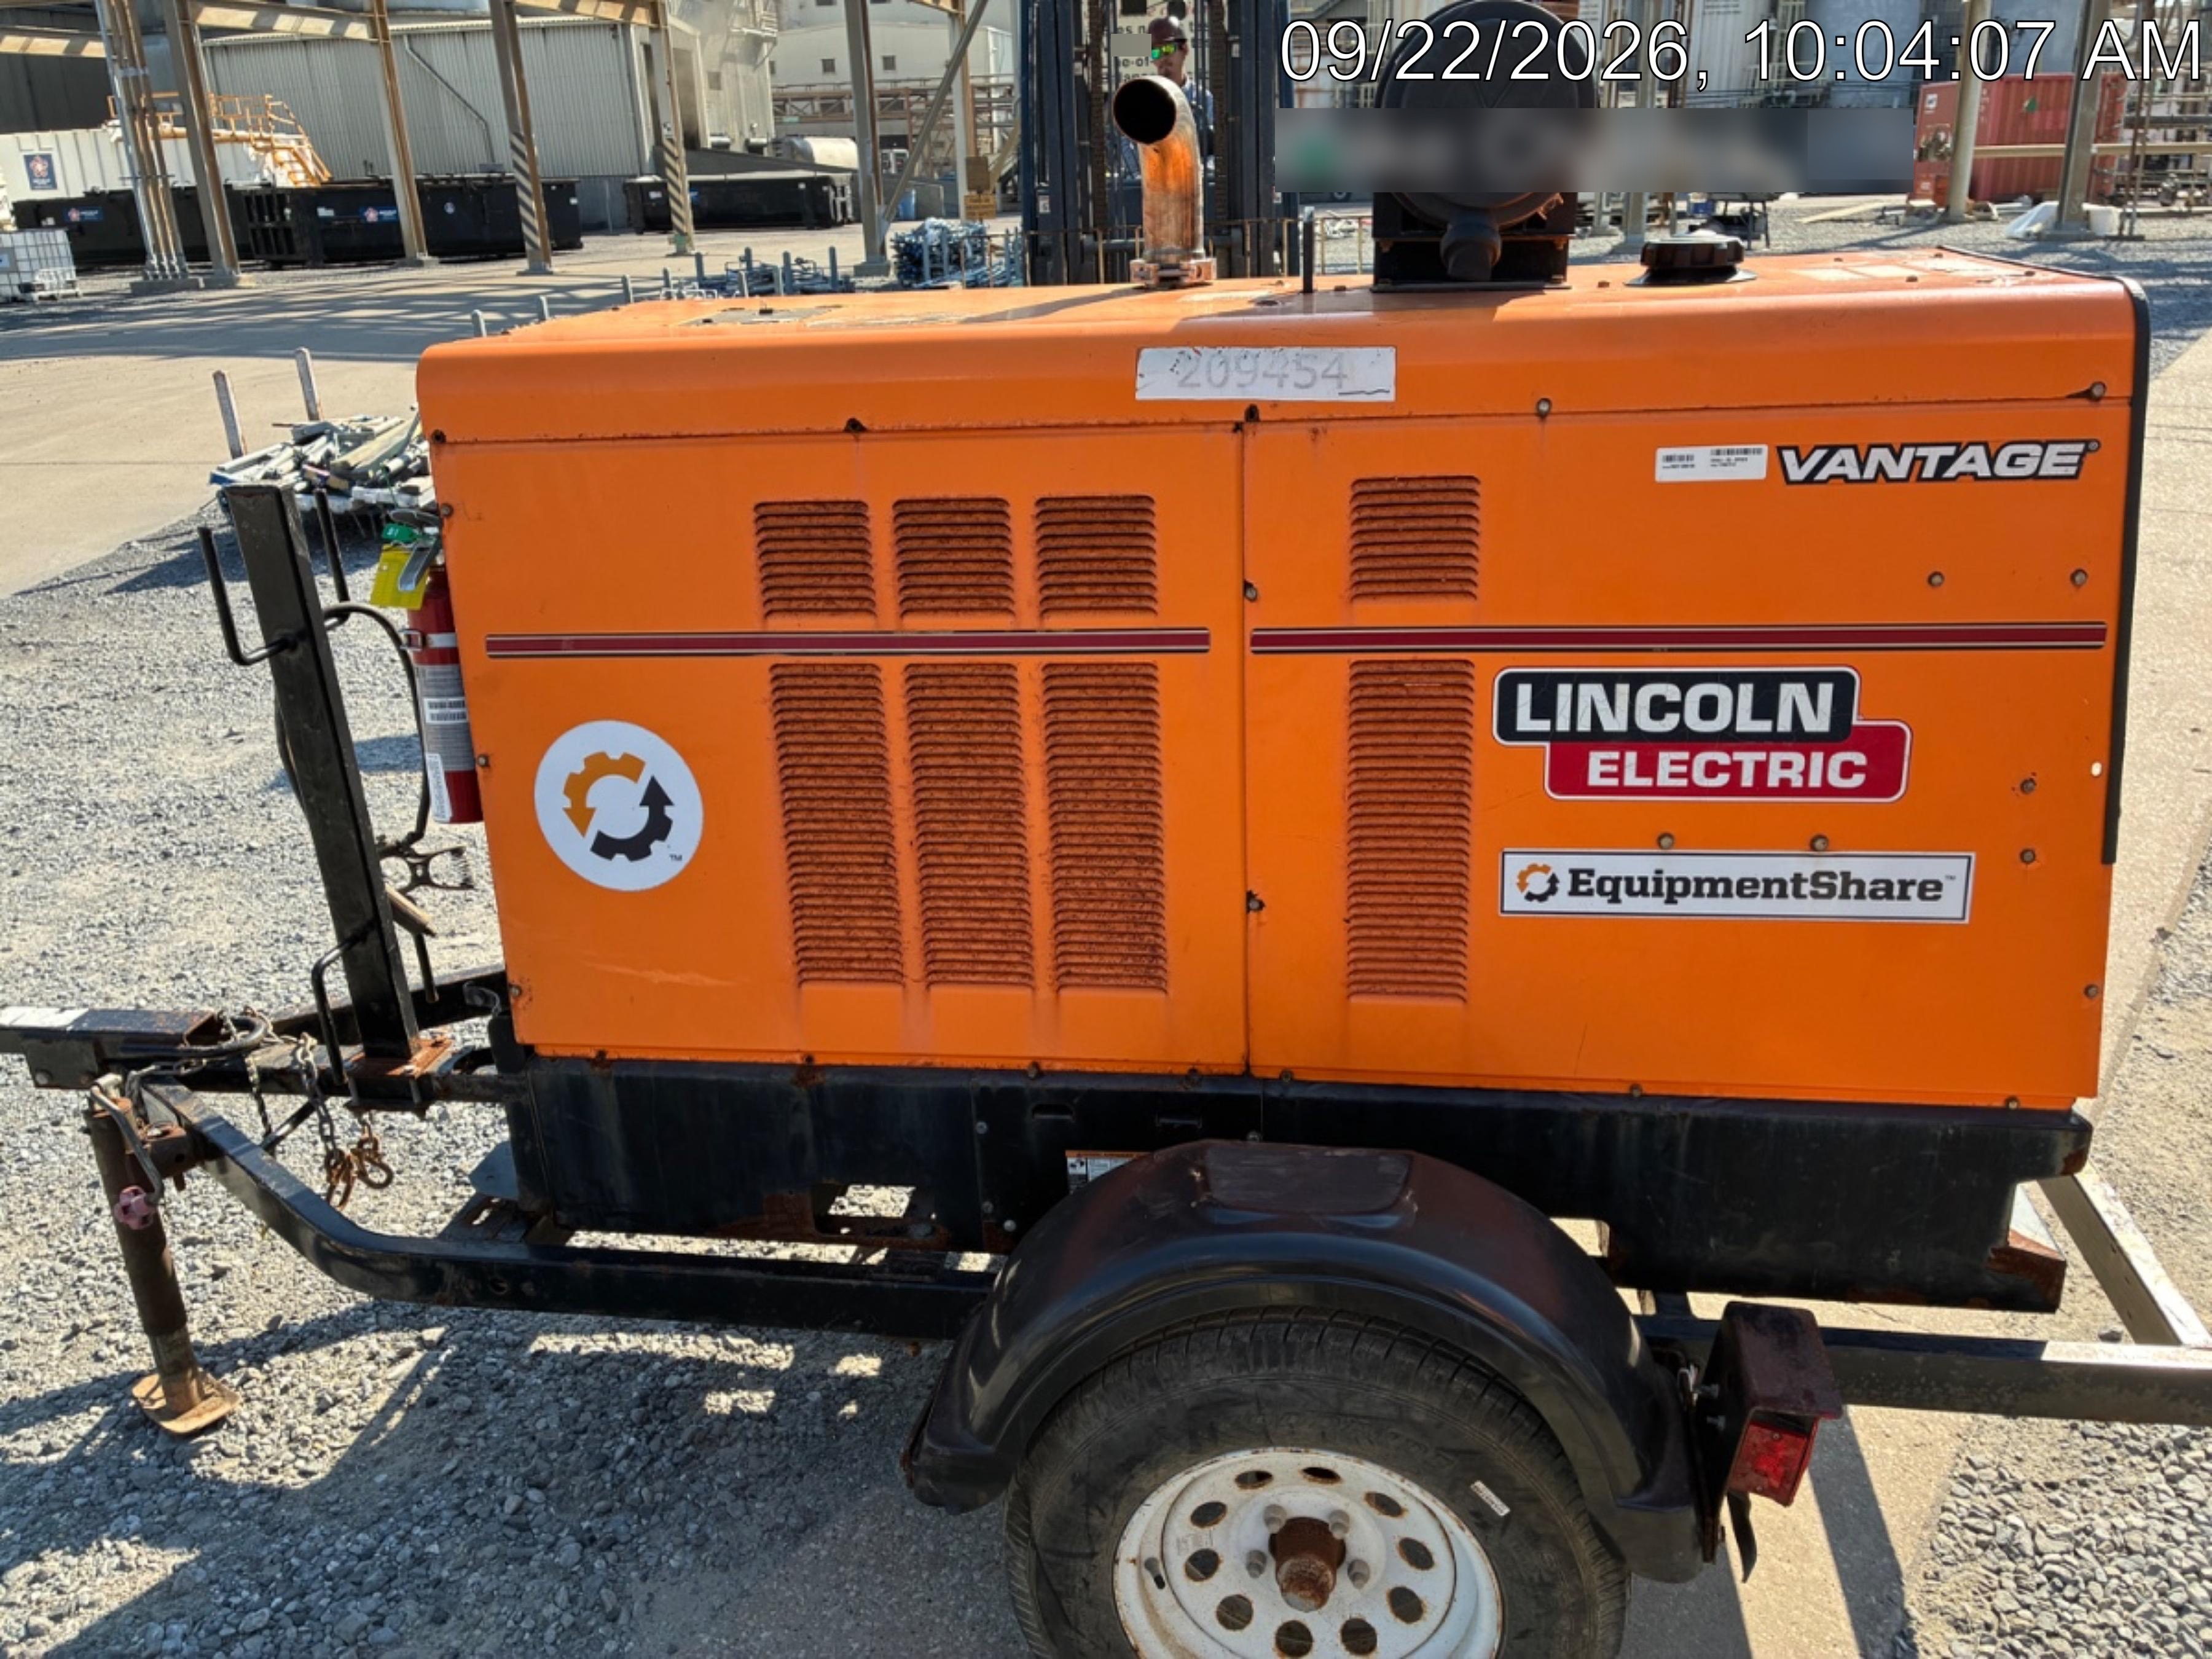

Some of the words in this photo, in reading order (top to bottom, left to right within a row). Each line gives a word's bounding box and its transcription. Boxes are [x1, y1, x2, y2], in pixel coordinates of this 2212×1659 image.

[1171, 350, 1348, 390] 209454
[1516, 682, 1834, 734] LINCOLN
[1587, 750, 1867, 788] ELECTRIC
